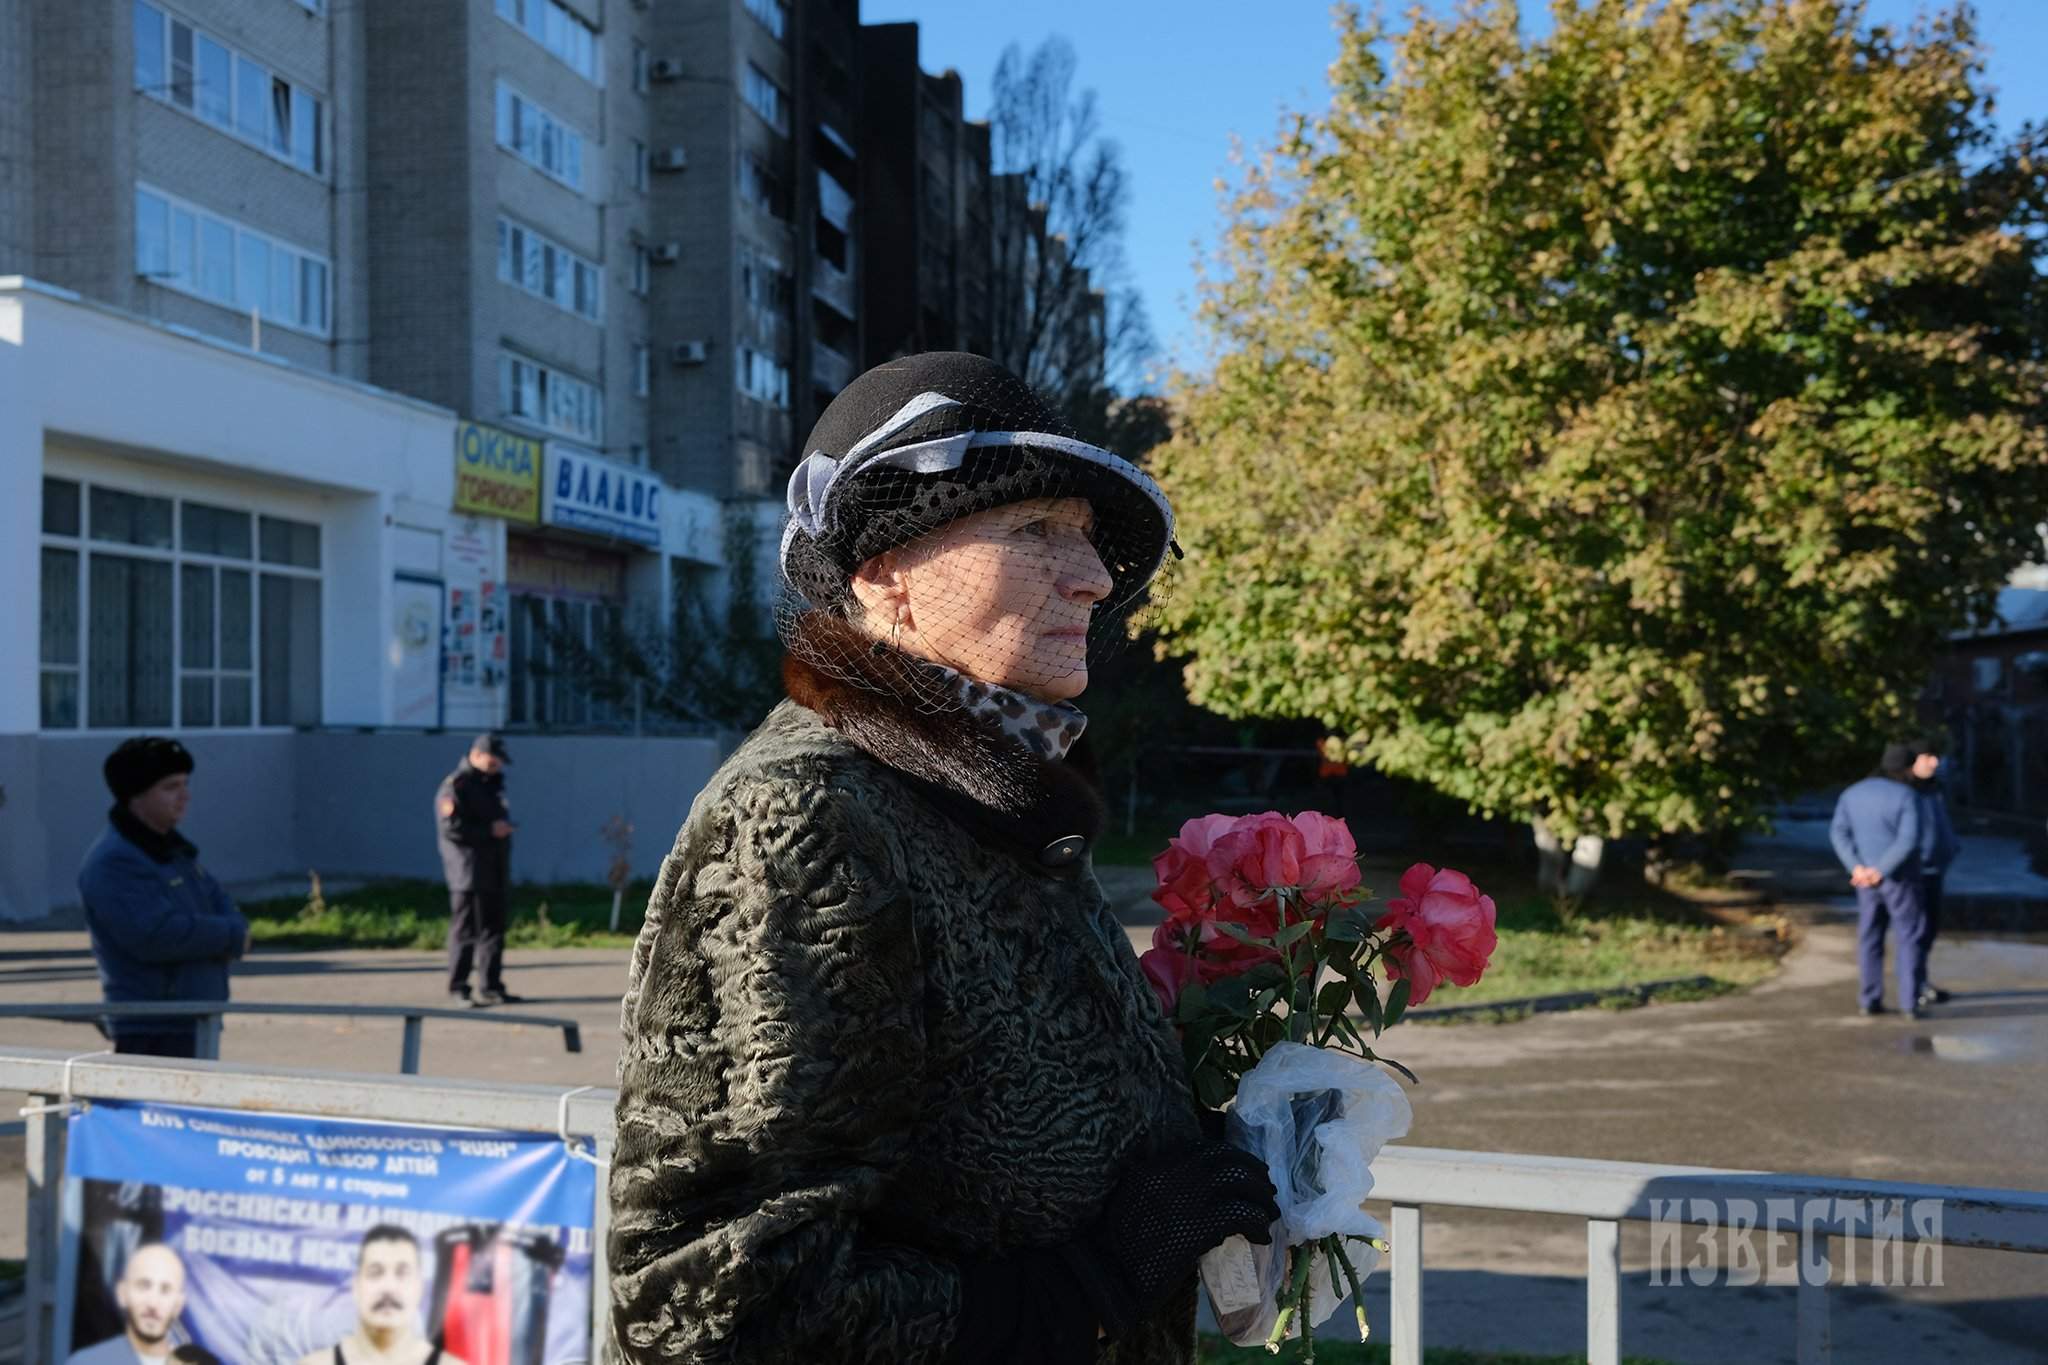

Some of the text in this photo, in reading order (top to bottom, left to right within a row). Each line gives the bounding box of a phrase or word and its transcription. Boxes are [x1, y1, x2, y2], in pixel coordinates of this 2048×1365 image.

[463, 426, 534, 479] ОКНА
[557, 457, 660, 521] ВЛАДОС
[218, 1139, 438, 1176] ПРОВОДИТ НАБОР ДЕТЕЙ
[246, 1169, 266, 1183] от
[291, 1174, 319, 1188] лет
[325, 1176, 337, 1190] и
